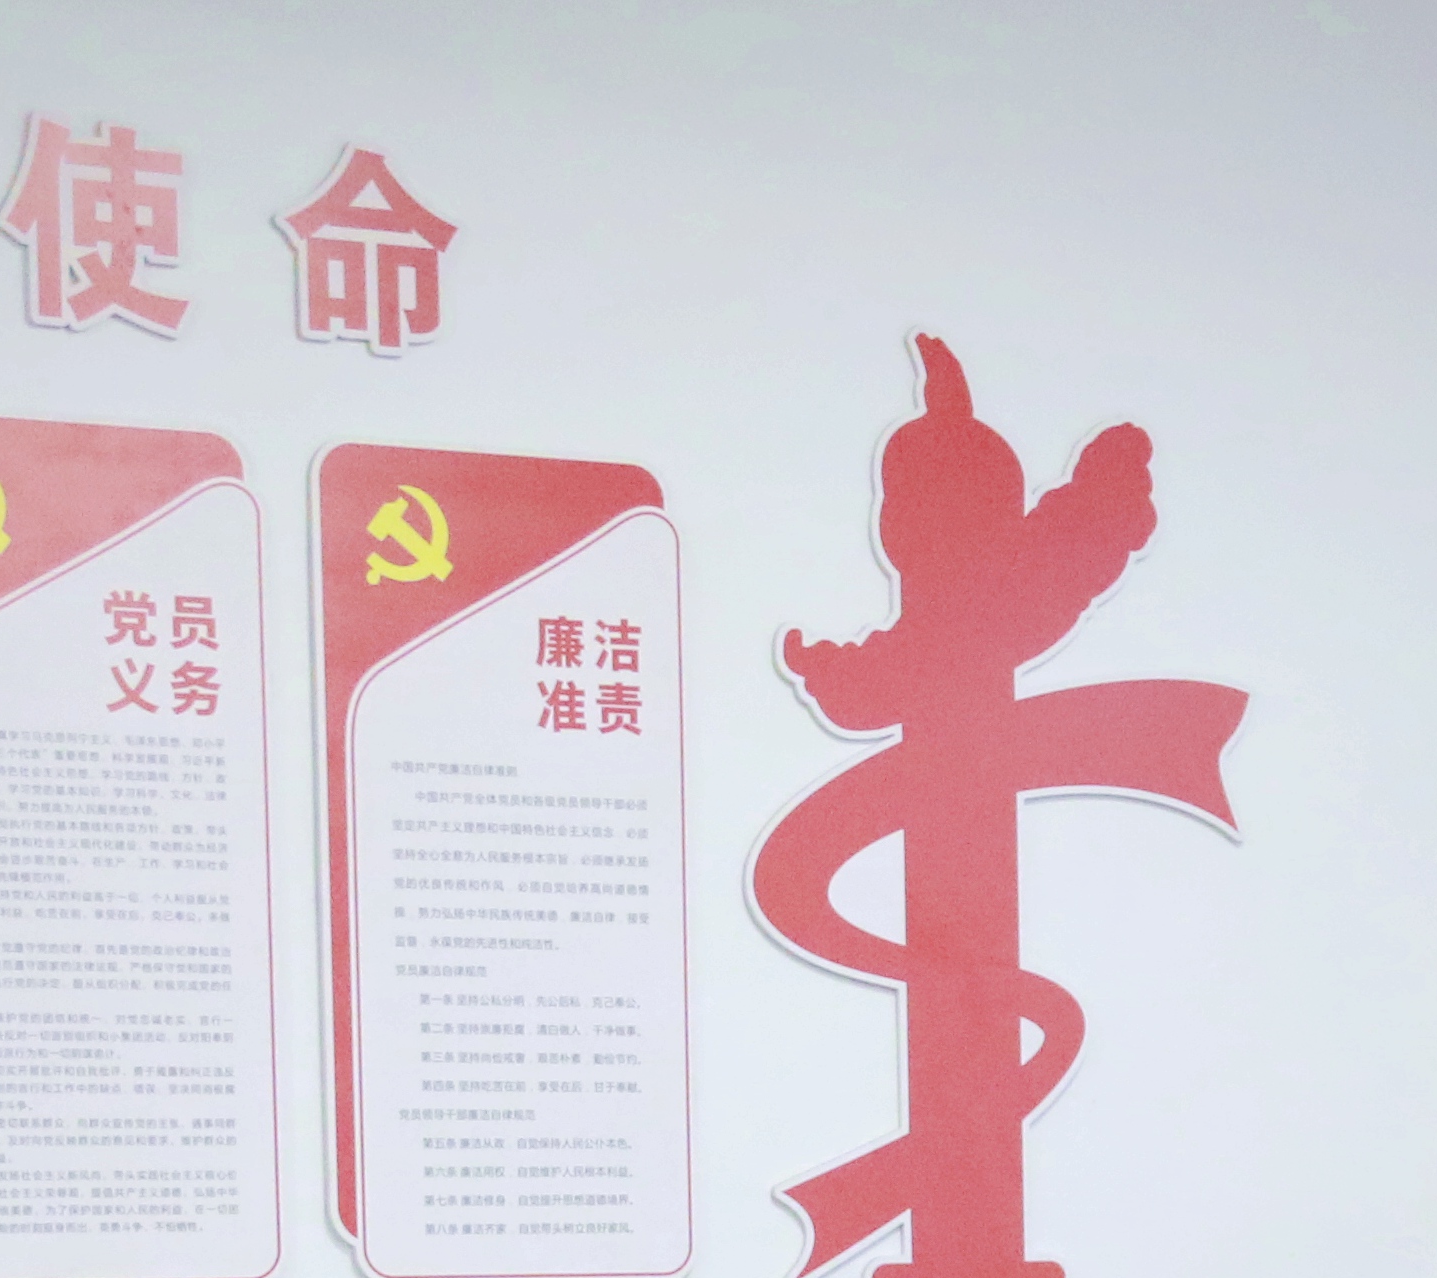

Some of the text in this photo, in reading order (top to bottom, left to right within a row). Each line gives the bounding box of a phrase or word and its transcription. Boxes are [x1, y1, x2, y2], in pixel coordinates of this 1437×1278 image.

[103, 589, 220, 651] 党员
[535, 616, 642, 673] 廉洁
[105, 657, 222, 717] 义务
[536, 679, 643, 736] 准责
